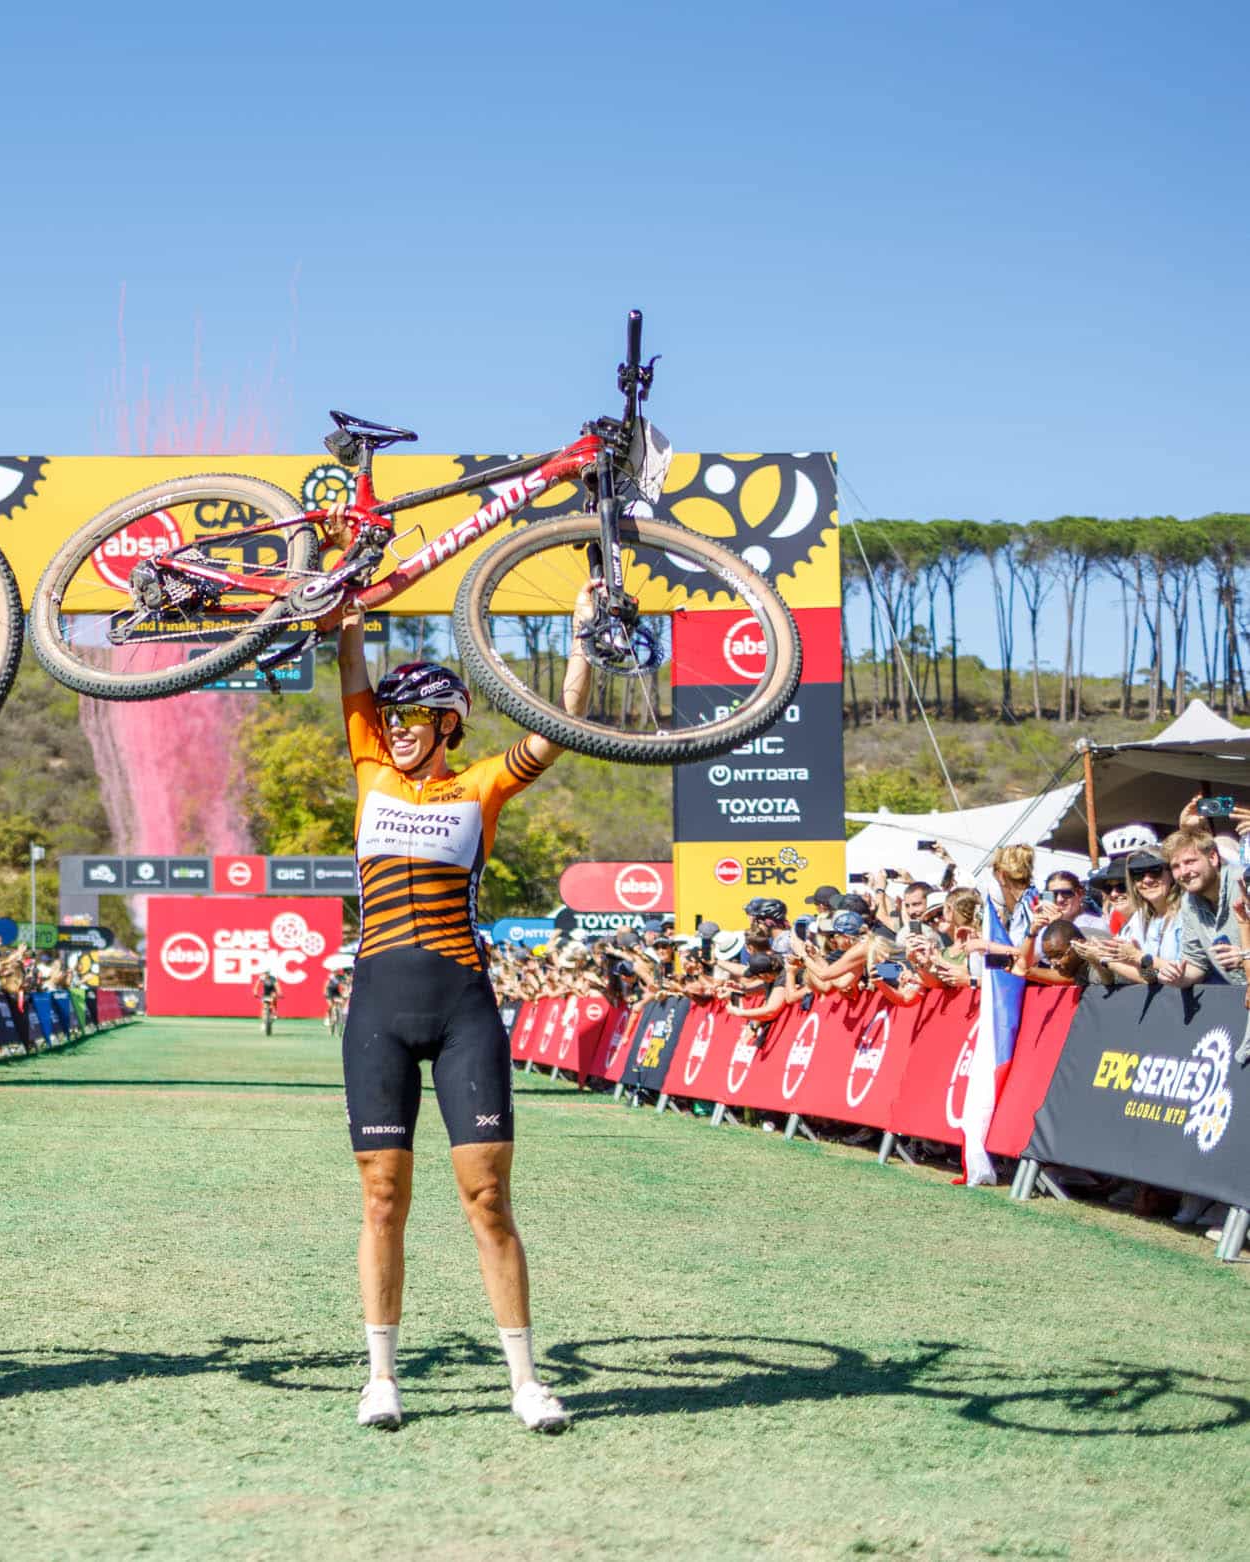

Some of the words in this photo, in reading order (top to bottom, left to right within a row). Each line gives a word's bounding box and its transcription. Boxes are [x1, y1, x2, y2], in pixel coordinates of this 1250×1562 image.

[195, 500, 273, 528] CAP
[105, 533, 170, 557] absa
[732, 635, 767, 655] abs
[717, 799, 800, 814] TOYOTA
[375, 820, 450, 837] maxon
[746, 857, 776, 866] CAPE
[276, 869, 305, 880] GIC
[746, 867, 797, 885] EPIC
[621, 879, 657, 893] absa
[574, 914, 646, 929] TOYOTA
[214, 930, 270, 949] CAPE
[214, 949, 307, 984] EPIC
[1124, 1101, 1162, 1121] GLOBAL
[1163, 1106, 1188, 1126] MTB
[362, 1125, 406, 1135] maxon
